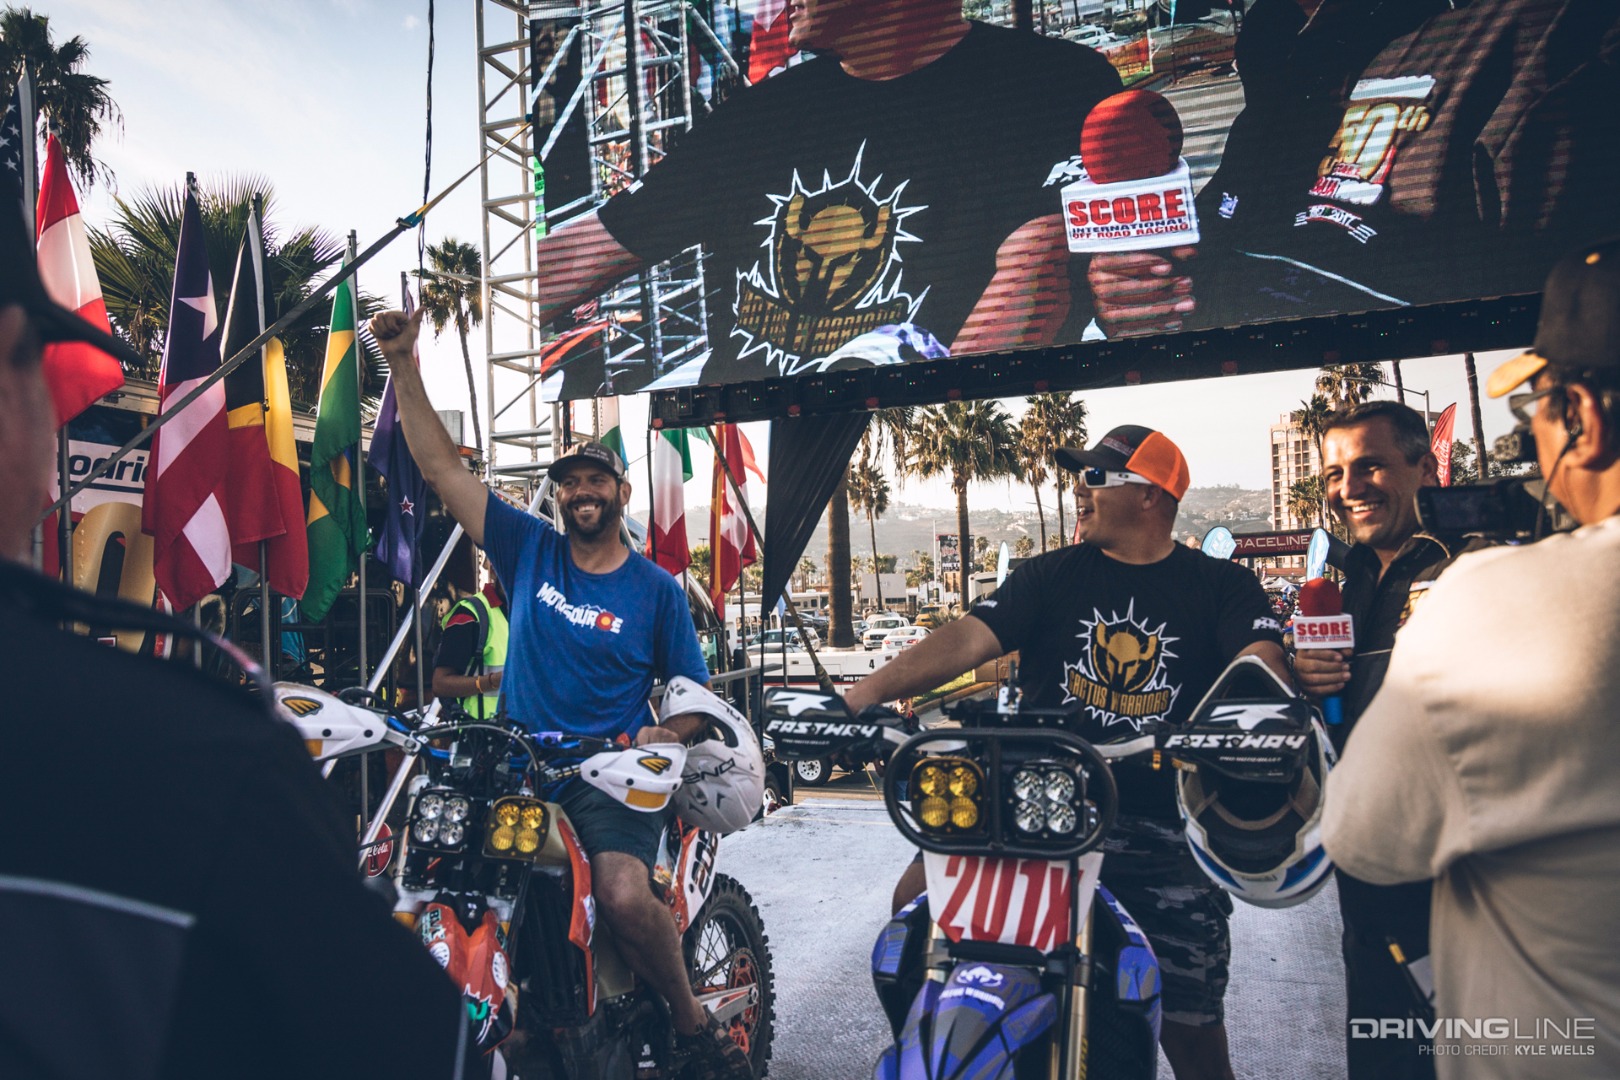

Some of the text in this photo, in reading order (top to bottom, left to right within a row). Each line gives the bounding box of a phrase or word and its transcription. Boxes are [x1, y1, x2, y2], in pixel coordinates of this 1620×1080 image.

[1068, 188, 1186, 226] SCORE
[1072, 218, 1183, 234] INTERNATIONAL
[1097, 231, 1131, 239] ROAD
[1136, 223, 1189, 236] RACING
[536, 582, 624, 635] MOTOSOURCE
[1296, 621, 1351, 636] SCORE
[869, 659, 875, 669] 4
[1069, 669, 1169, 716] CACTUS WARRIORS
[766, 720, 878, 738] FASTWAY
[1164, 734, 1307, 749] FASTWAY
